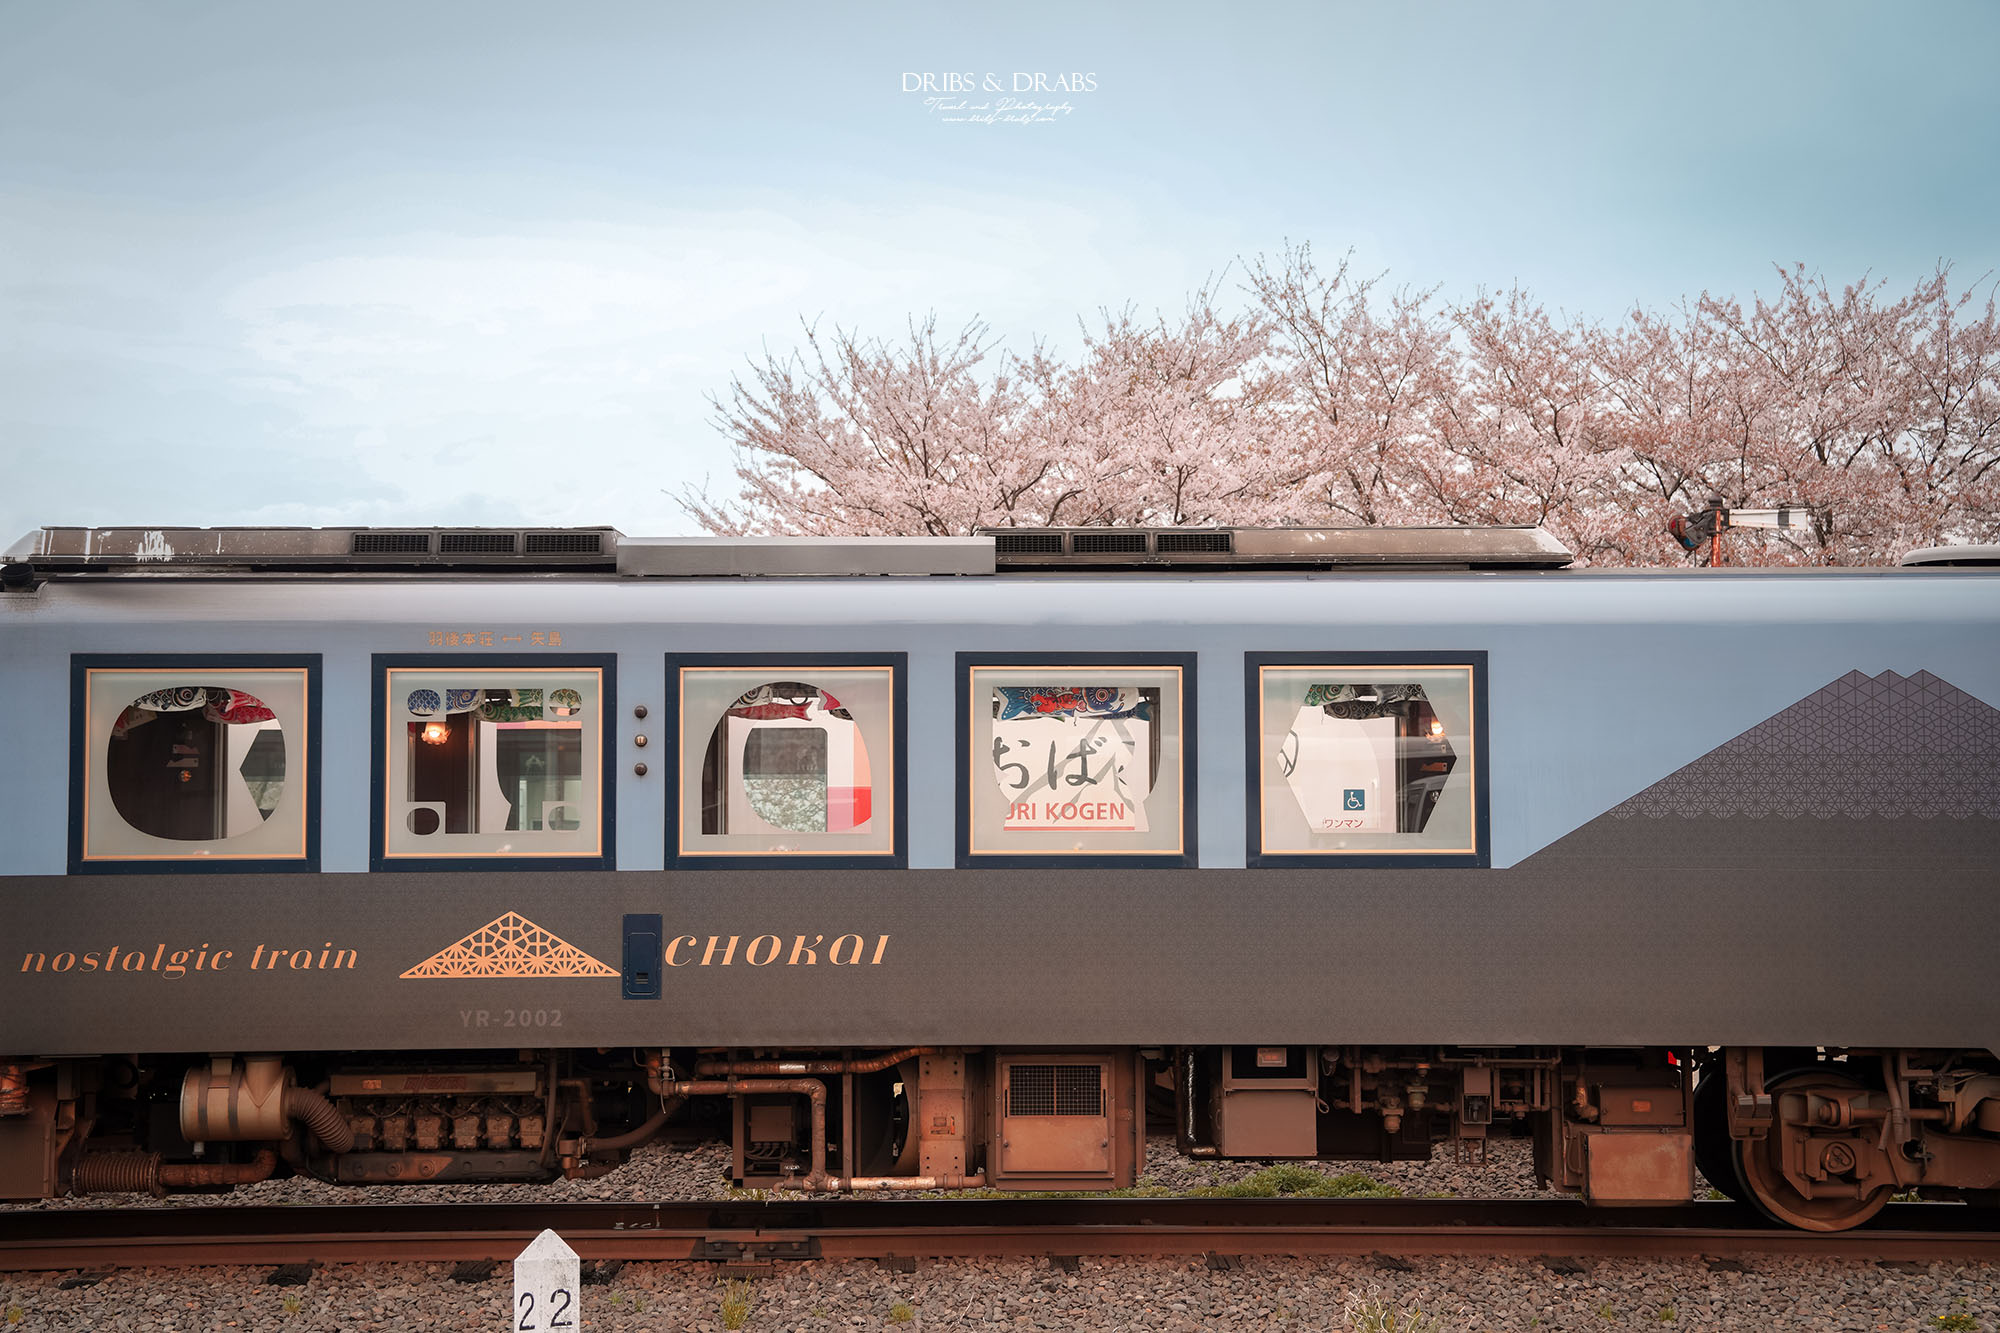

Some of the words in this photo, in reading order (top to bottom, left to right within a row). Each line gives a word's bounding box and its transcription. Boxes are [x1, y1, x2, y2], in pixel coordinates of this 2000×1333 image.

[428, 631, 496, 647] 羽後本荘
[529, 631, 562, 647] 矢島
[1046, 803, 1125, 820] KOGEN
[1323, 818, 1364, 829] ワンマン
[20, 943, 234, 980] nostalgic
[250, 941, 359, 970] train
[664, 933, 892, 967] CHOKAI
[460, 1008, 563, 1028] YR-2002
